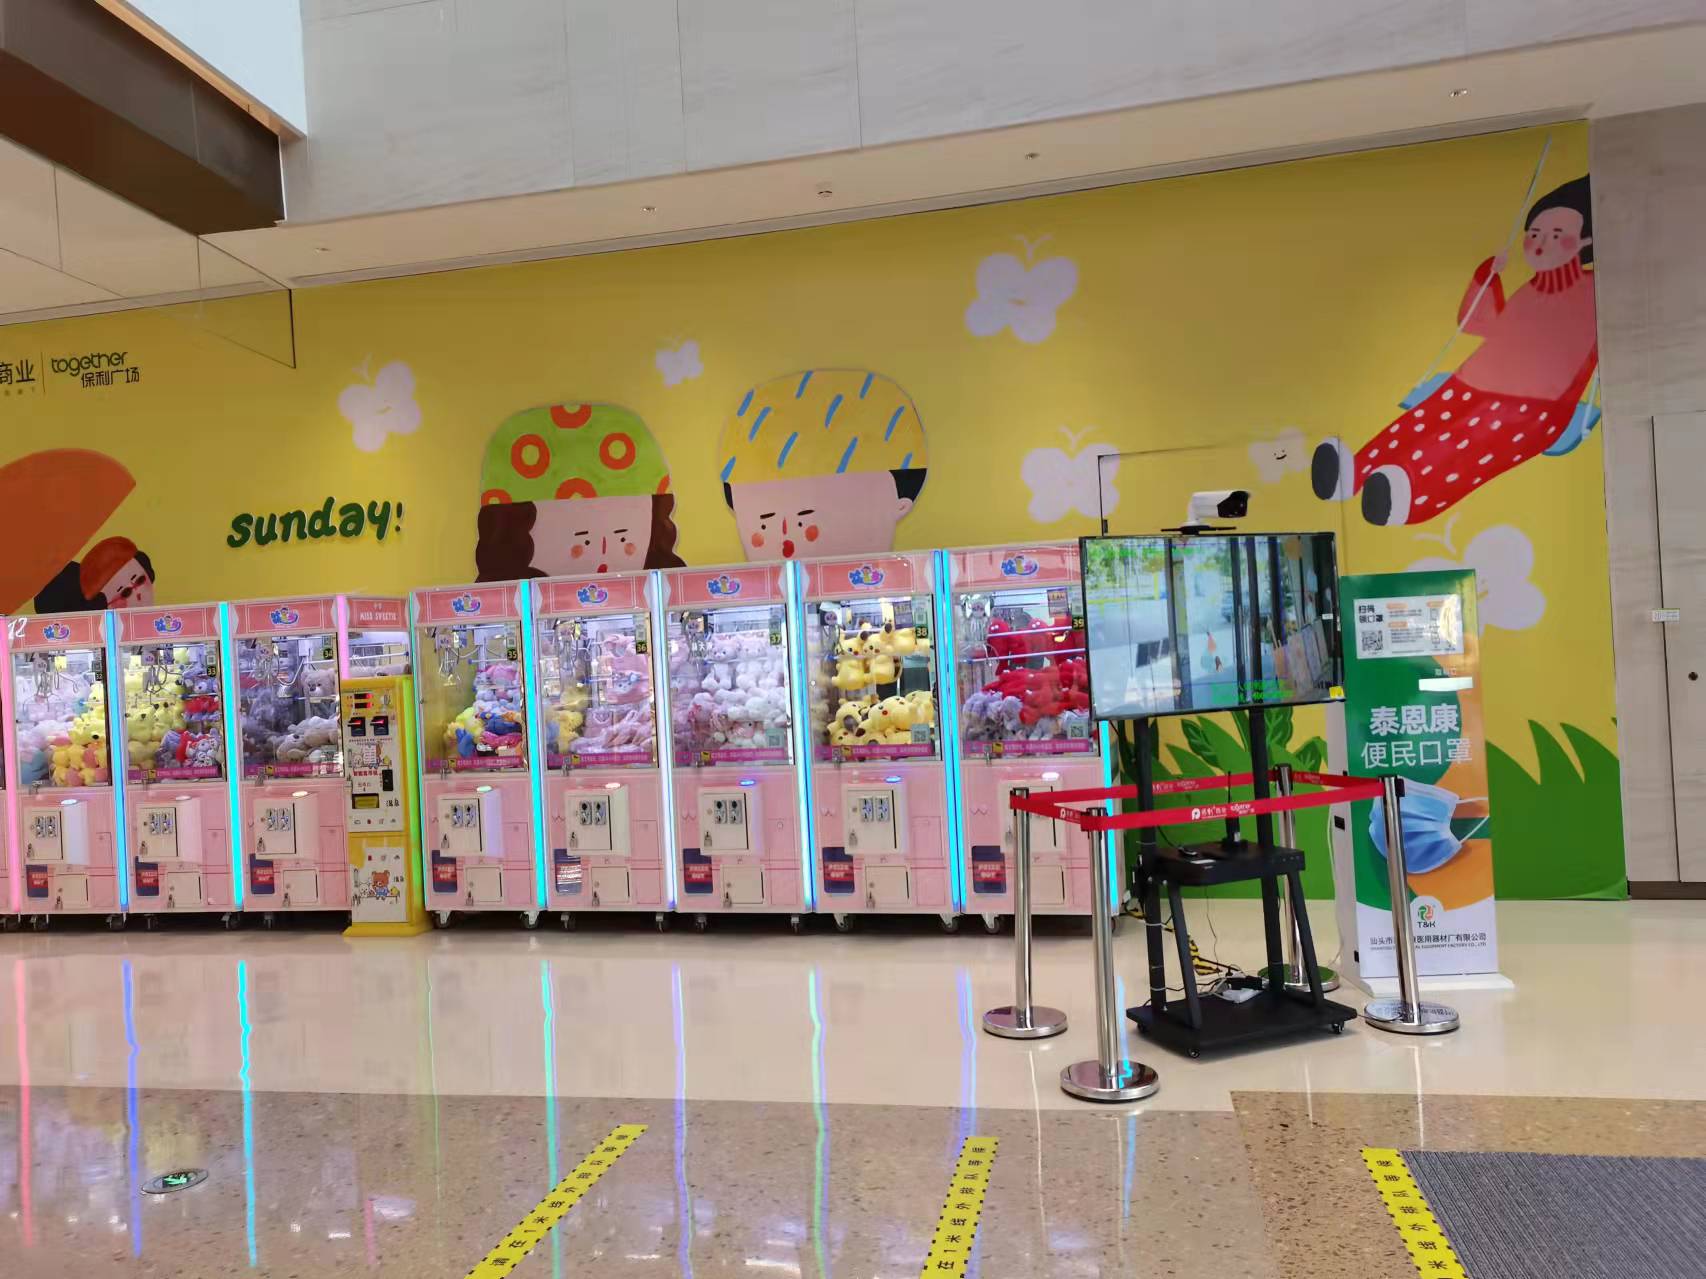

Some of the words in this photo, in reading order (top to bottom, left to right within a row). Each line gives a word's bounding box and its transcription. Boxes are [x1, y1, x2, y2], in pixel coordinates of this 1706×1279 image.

[51, 351, 128, 377] together
[81, 366, 140, 388] 保利广场
[227, 496, 403, 548] sunday!
[1358, 604, 1375, 614] 扫码
[1073, 619, 1084, 629] 39
[916, 627, 927, 637] 38
[770, 634, 781, 644] 37
[636, 643, 646, 653] 36
[324, 649, 333, 659] 34
[508, 650, 517, 660] 35
[207, 666, 216, 676] 33
[1369, 702, 1460, 736] 泰恩康
[1361, 738, 1473, 769] 便民口罩
